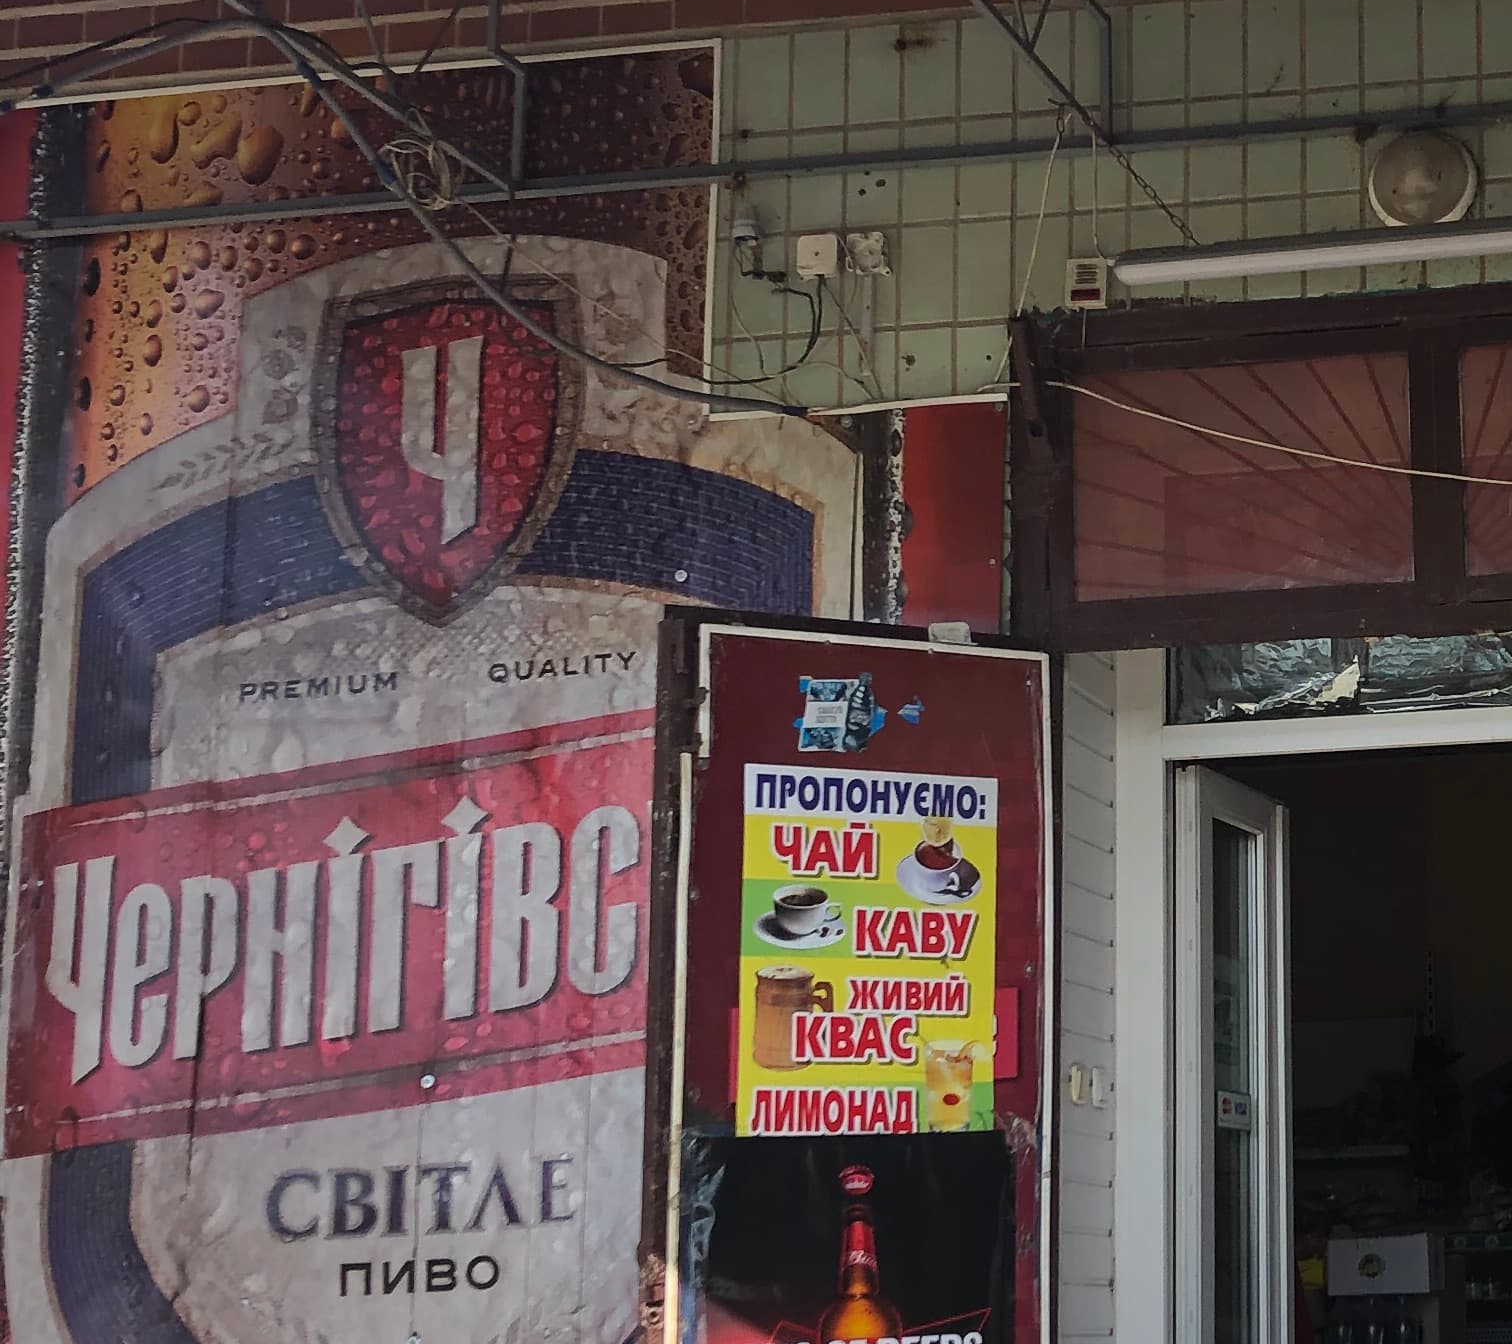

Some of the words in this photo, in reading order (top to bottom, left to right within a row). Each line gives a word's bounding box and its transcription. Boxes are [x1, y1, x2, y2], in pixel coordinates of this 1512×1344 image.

[239, 670, 399, 704] PREMIUM
[487, 650, 638, 684] QUALITY
[754, 772, 987, 820] ПРОПОНУЄМО:
[772, 821, 877, 877] ЧАЙ
[854, 908, 977, 957] КАВУ
[847, 974, 968, 1014] ЖИВИЙ
[793, 1013, 918, 1061] КВАС
[750, 1088, 918, 1135] ЛИМОНАД
[265, 1157, 578, 1244] СВІТЛЕ
[338, 1254, 500, 1297] ПИВО
